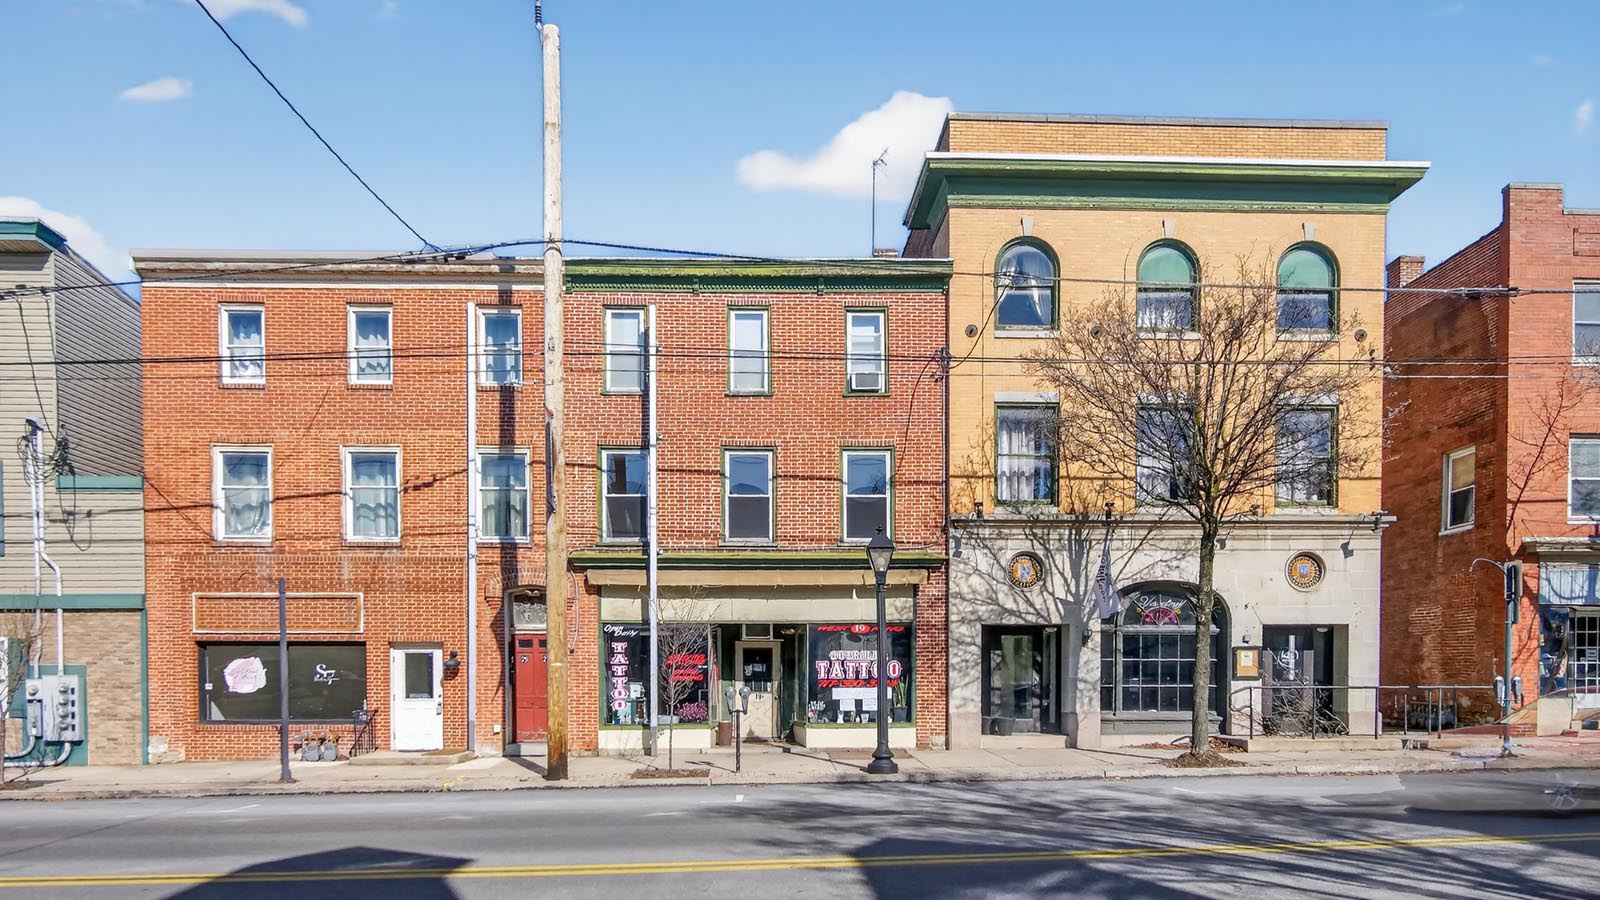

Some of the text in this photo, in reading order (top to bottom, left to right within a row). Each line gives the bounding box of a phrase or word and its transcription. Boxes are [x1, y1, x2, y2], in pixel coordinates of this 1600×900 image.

[604, 624, 624, 633] Open
[613, 629, 639, 637] Daily
[611, 642, 629, 710] TATTOO
